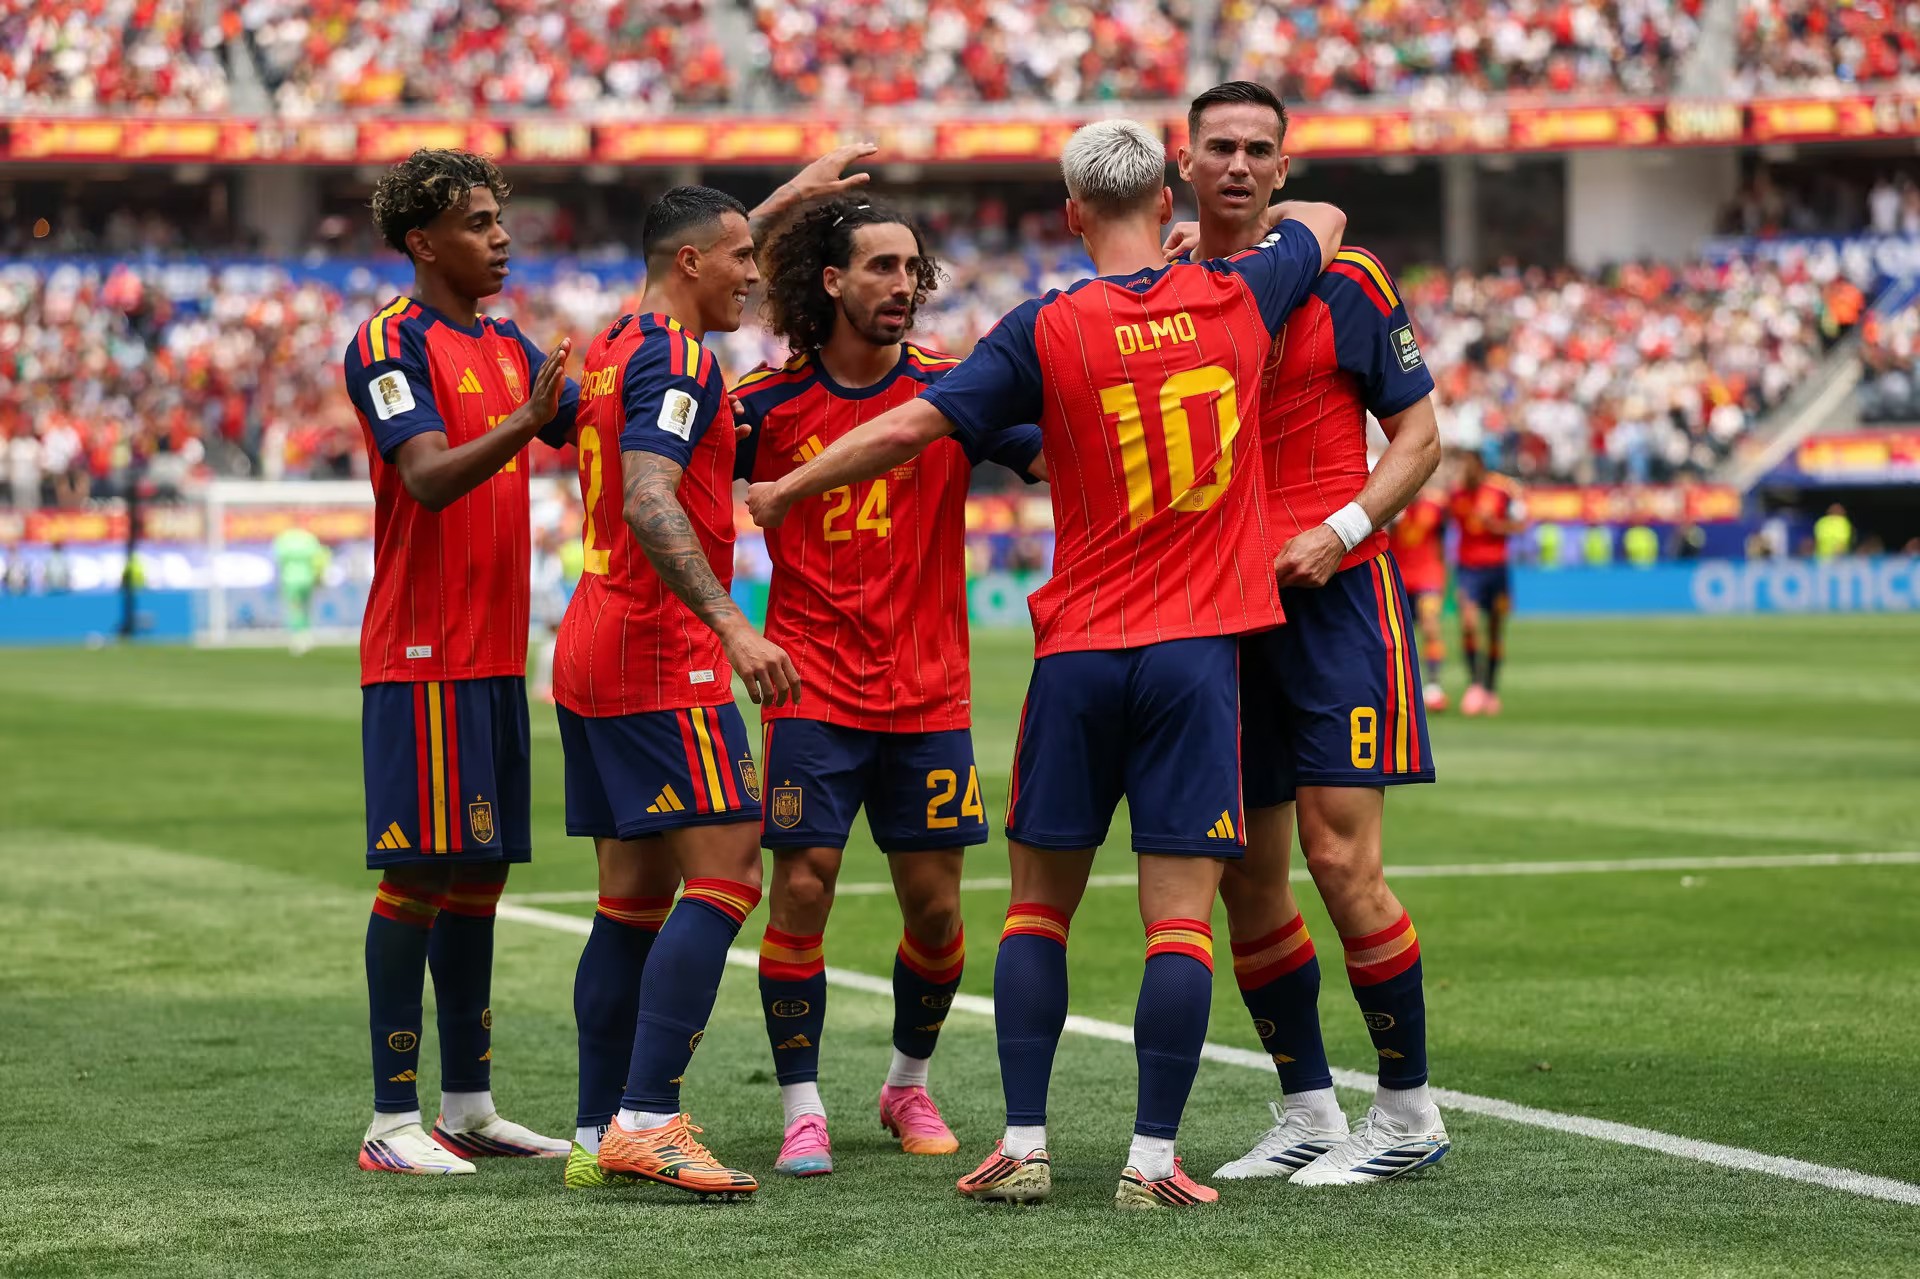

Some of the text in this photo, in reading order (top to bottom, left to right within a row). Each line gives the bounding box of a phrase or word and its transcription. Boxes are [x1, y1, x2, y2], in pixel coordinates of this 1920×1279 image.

[1115, 312, 1196, 355] OLMO
[1098, 365, 1241, 531] 10
[823, 479, 891, 541] 24
[1692, 557, 1920, 614] aramc
[1351, 706, 1377, 769] 8
[926, 765, 984, 829] 24
